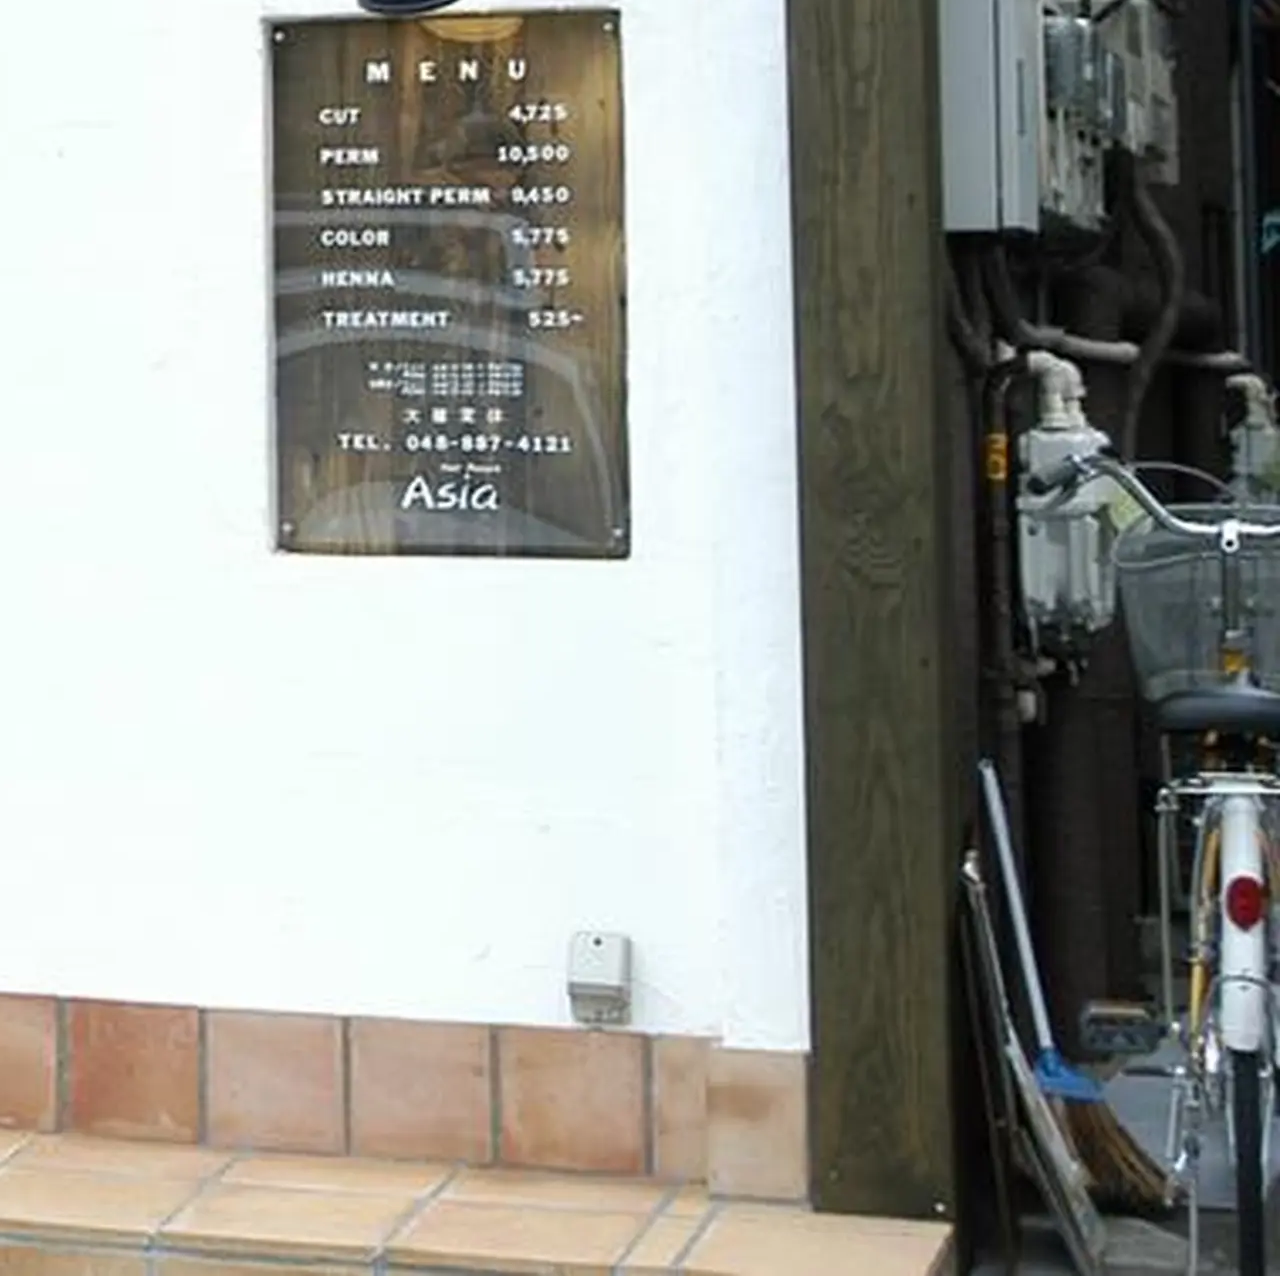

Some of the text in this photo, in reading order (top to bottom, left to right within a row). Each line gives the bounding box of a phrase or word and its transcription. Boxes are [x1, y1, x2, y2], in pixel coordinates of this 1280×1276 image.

[366, 58, 526, 82] MENU
[318, 102, 568, 126] CUT 4,725
[319, 144, 570, 165] PERM 10,500
[321, 187, 423, 206] STRAIGHT
[429, 186, 491, 205] PERM
[320, 228, 390, 247] COLOR
[321, 270, 395, 288] HENNA
[323, 310, 448, 328] TREATMENT
[338, 433, 391, 452] TEL.
[400, 472, 499, 511] Asia
